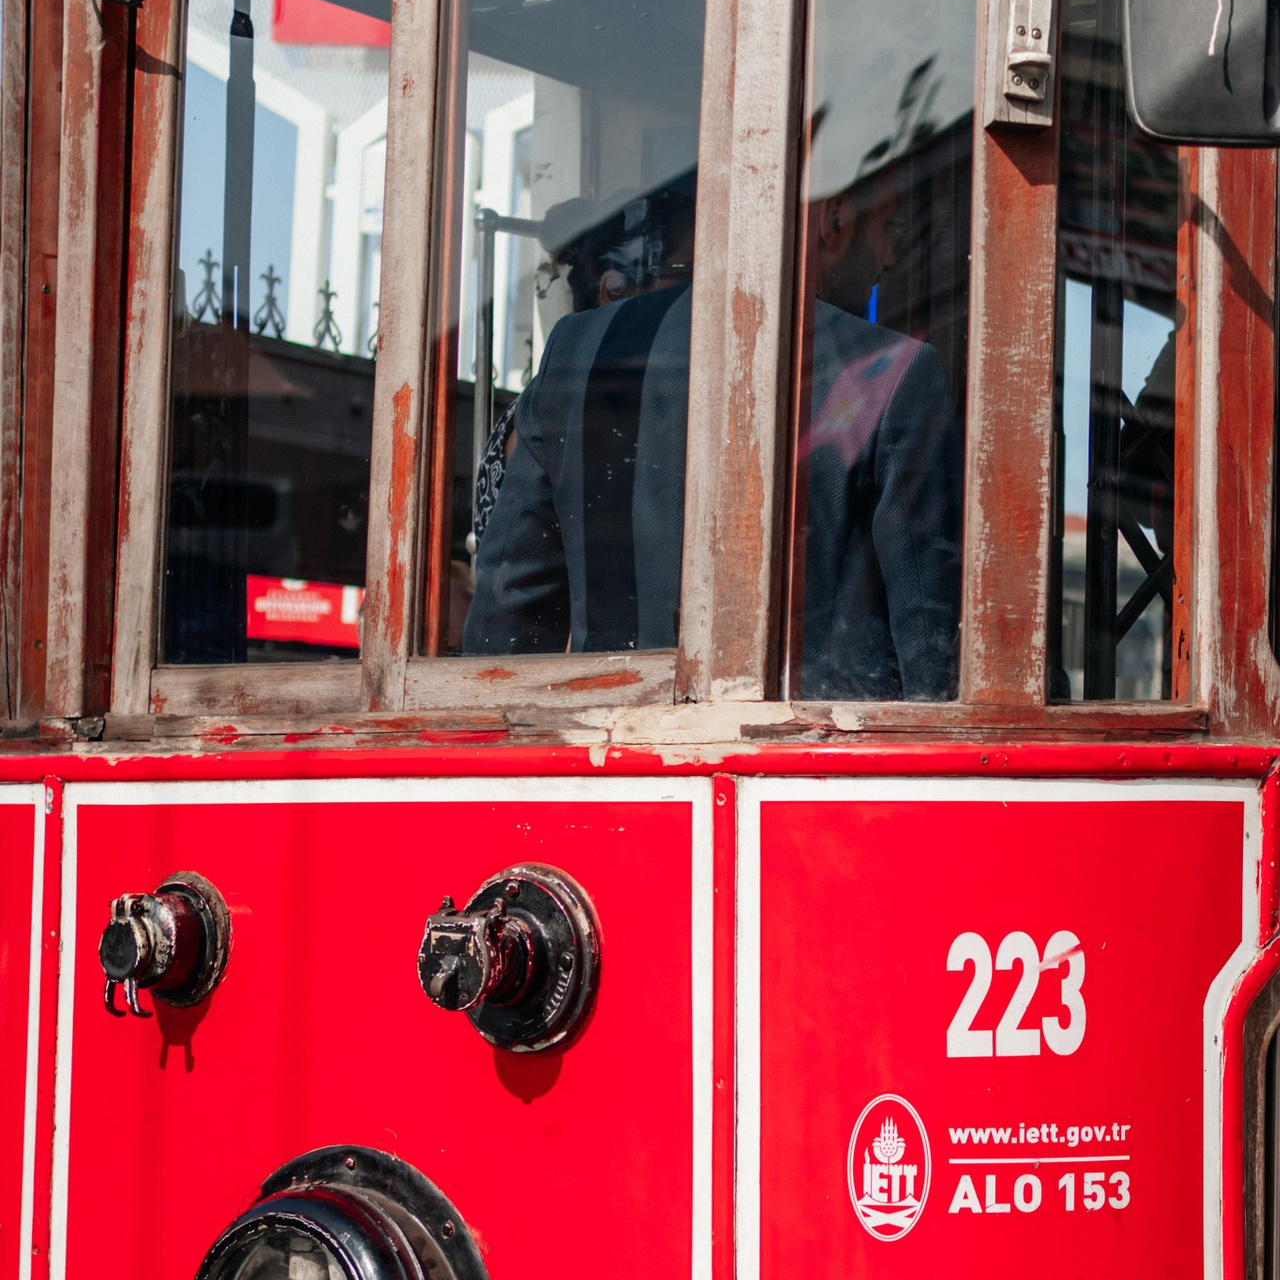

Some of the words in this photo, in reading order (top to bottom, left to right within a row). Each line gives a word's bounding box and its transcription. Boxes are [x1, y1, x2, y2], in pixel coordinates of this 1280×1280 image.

[946, 930, 1087, 1058] 223
[948, 1122, 1131, 1148] www.iett.gov.tr
[948, 1173, 1042, 1214] ALO
[1058, 1171, 1131, 1212] 153
